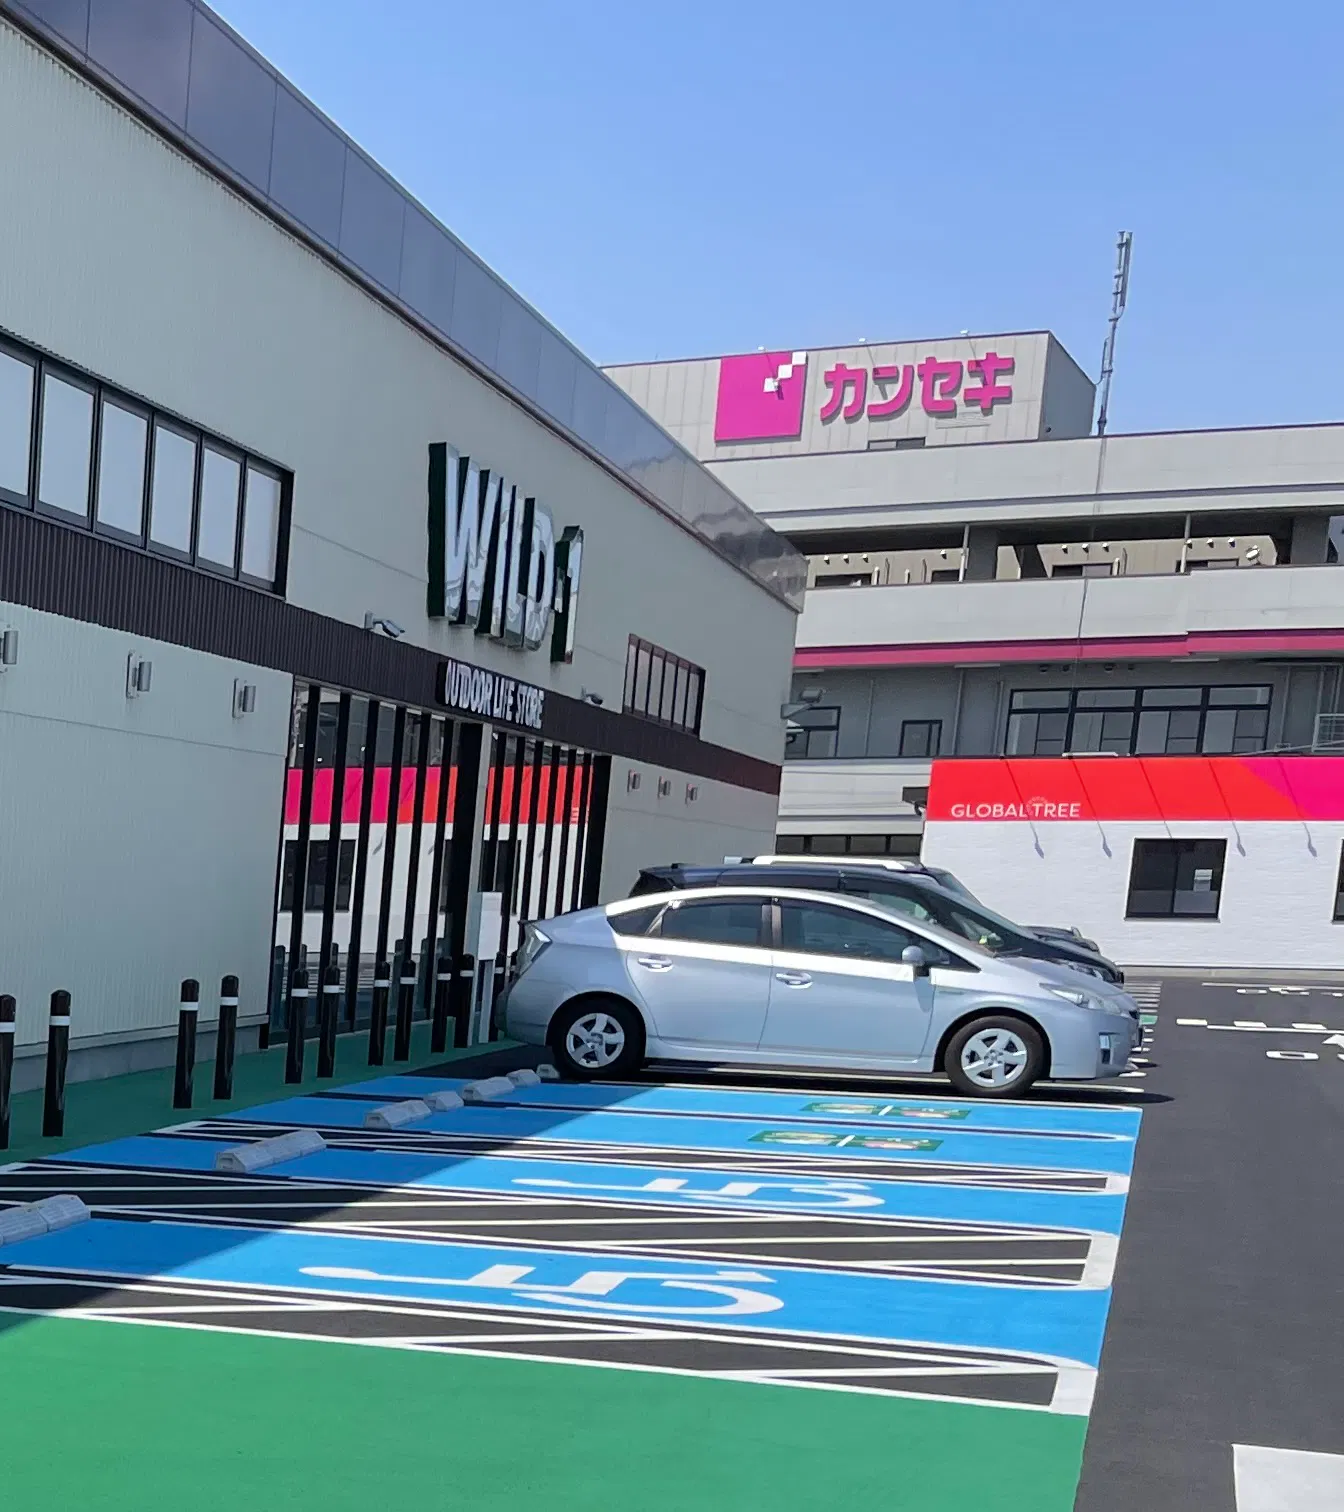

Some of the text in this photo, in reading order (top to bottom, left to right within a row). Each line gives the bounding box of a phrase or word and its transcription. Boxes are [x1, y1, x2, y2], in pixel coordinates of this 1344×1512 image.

[820, 352, 1015, 420] カンセキ
[428, 441, 584, 663] WILD-1
[444, 659, 545, 730] OUTDOOR LIFE STORE
[950, 802, 1081, 818] GLOBAL TREE
